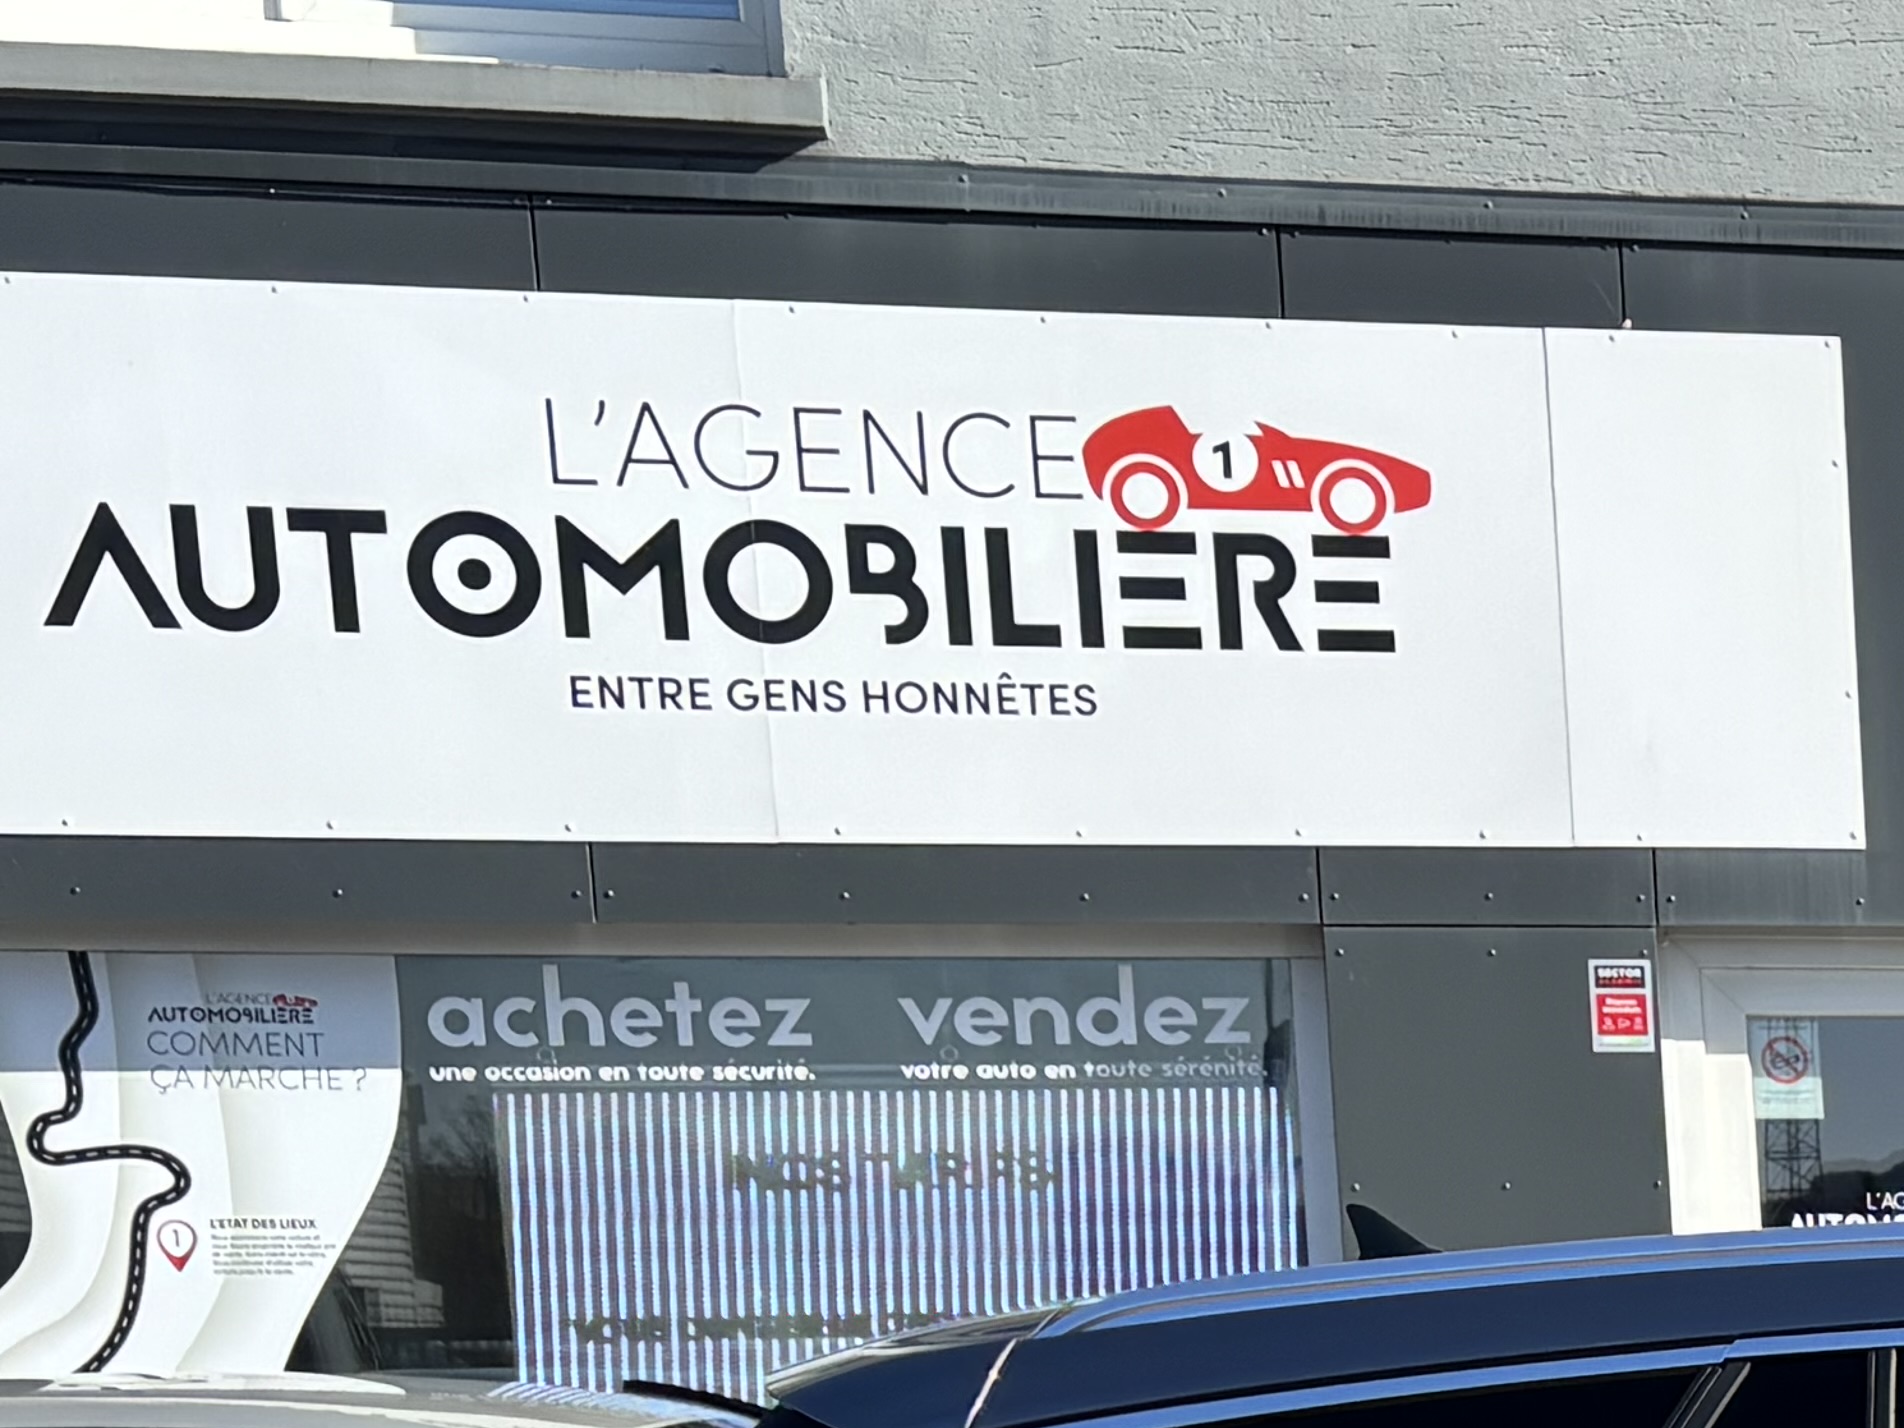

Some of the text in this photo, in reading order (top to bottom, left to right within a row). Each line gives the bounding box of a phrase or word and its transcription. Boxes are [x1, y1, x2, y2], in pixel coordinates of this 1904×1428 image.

[546, 398, 1083, 500] L'AGENCE
[1213, 441, 1232, 479] 1
[44, 501, 1396, 653] AUTOMOBILIERE
[570, 672, 1098, 716] ENTRE GENS HONNÊTES
[428, 964, 1250, 1048] achetez vendez
[147, 1030, 325, 1058] COMMENT
[150, 1064, 195, 1095] ÇA
[204, 1065, 343, 1092] MARCHE
[430, 1066, 477, 1081] une
[485, 1062, 591, 1082] occasion
[598, 1066, 631, 1081] en
[637, 1064, 704, 1081] toute
[712, 1059, 816, 1081] sécurité.
[900, 1062, 969, 1080] votre
[976, 1062, 1036, 1080] auto
[1044, 1064, 1077, 1080] en
[1084, 1061, 1152, 1079] toute
